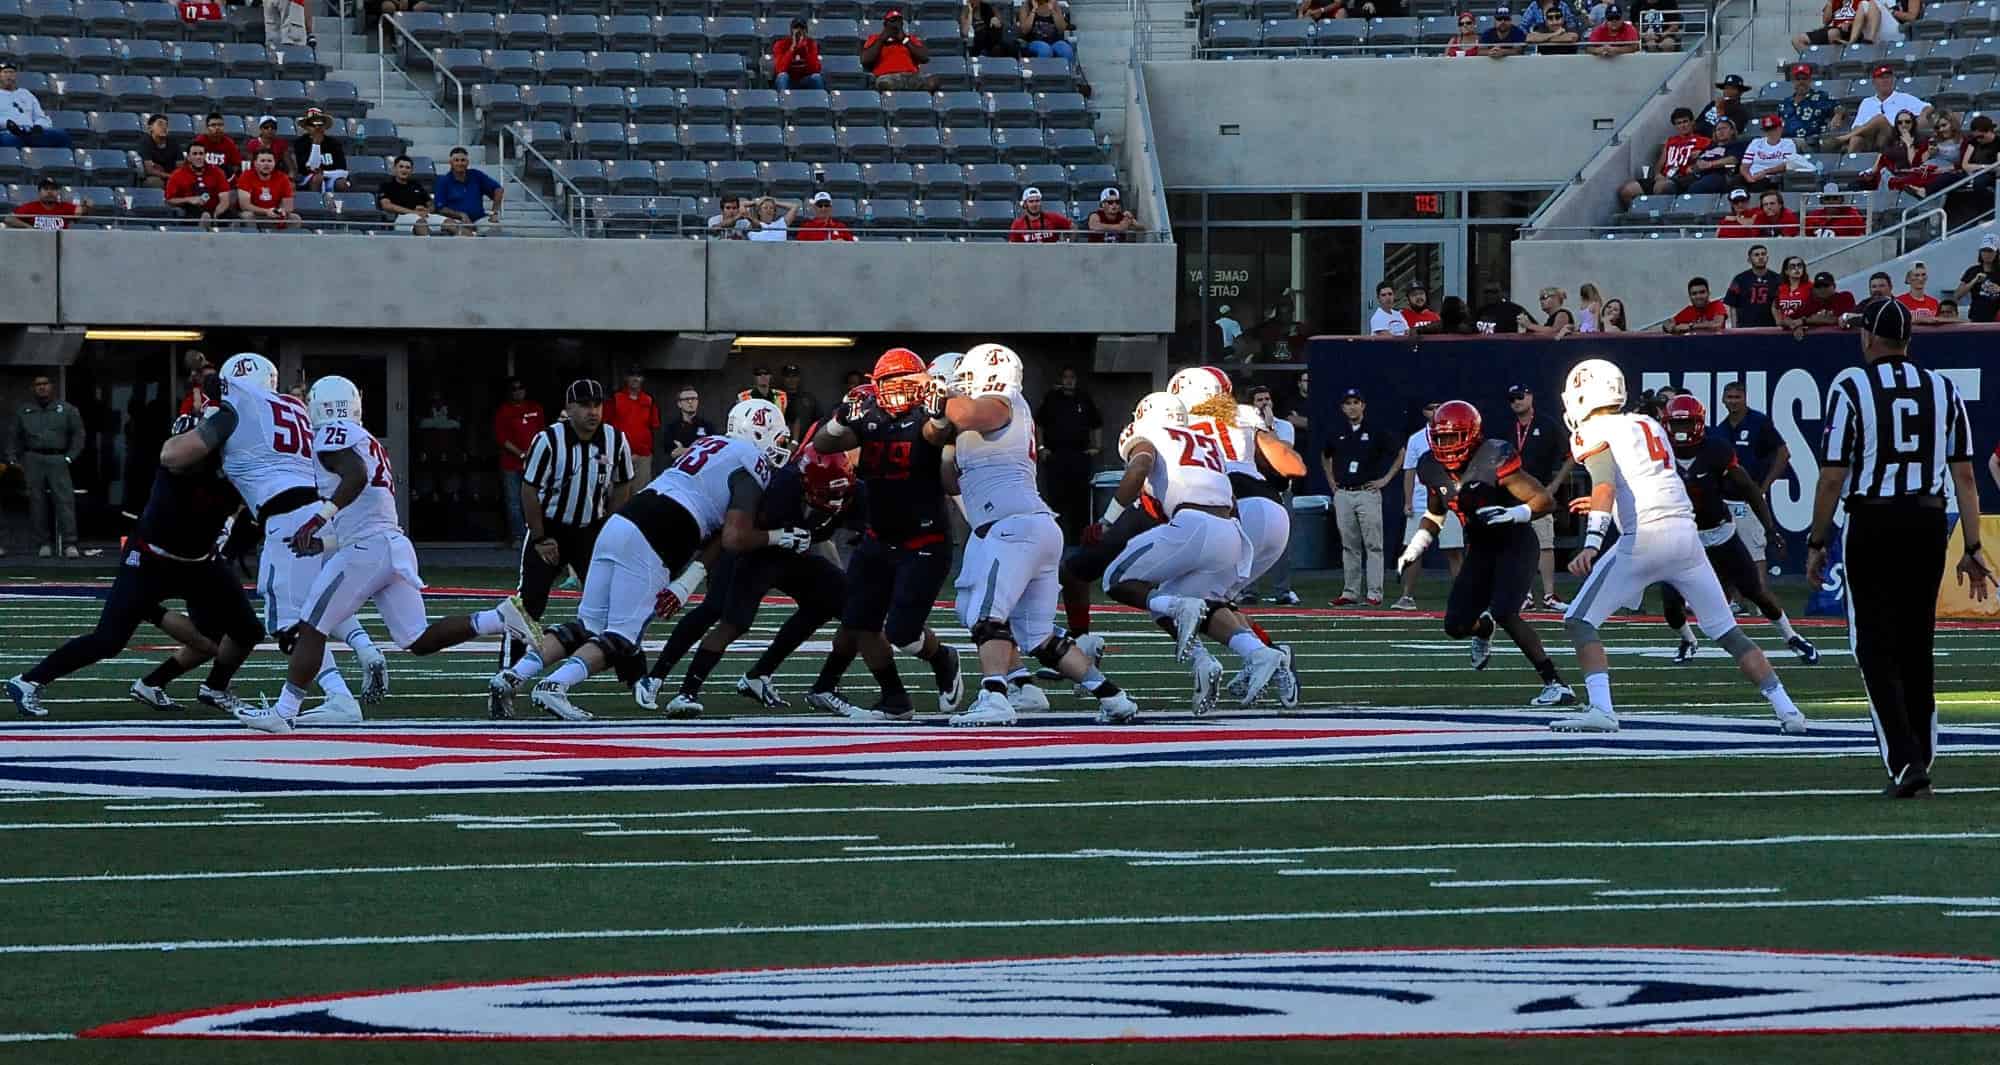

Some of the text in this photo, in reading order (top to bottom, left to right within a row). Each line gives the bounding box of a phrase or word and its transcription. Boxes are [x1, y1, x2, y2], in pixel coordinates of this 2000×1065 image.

[324, 426, 348, 445] 25
[336, 409, 348, 418] 25
[1892, 398, 1919, 453] C
[1168, 427, 1223, 473] 23
[1635, 420, 1673, 469] 4
